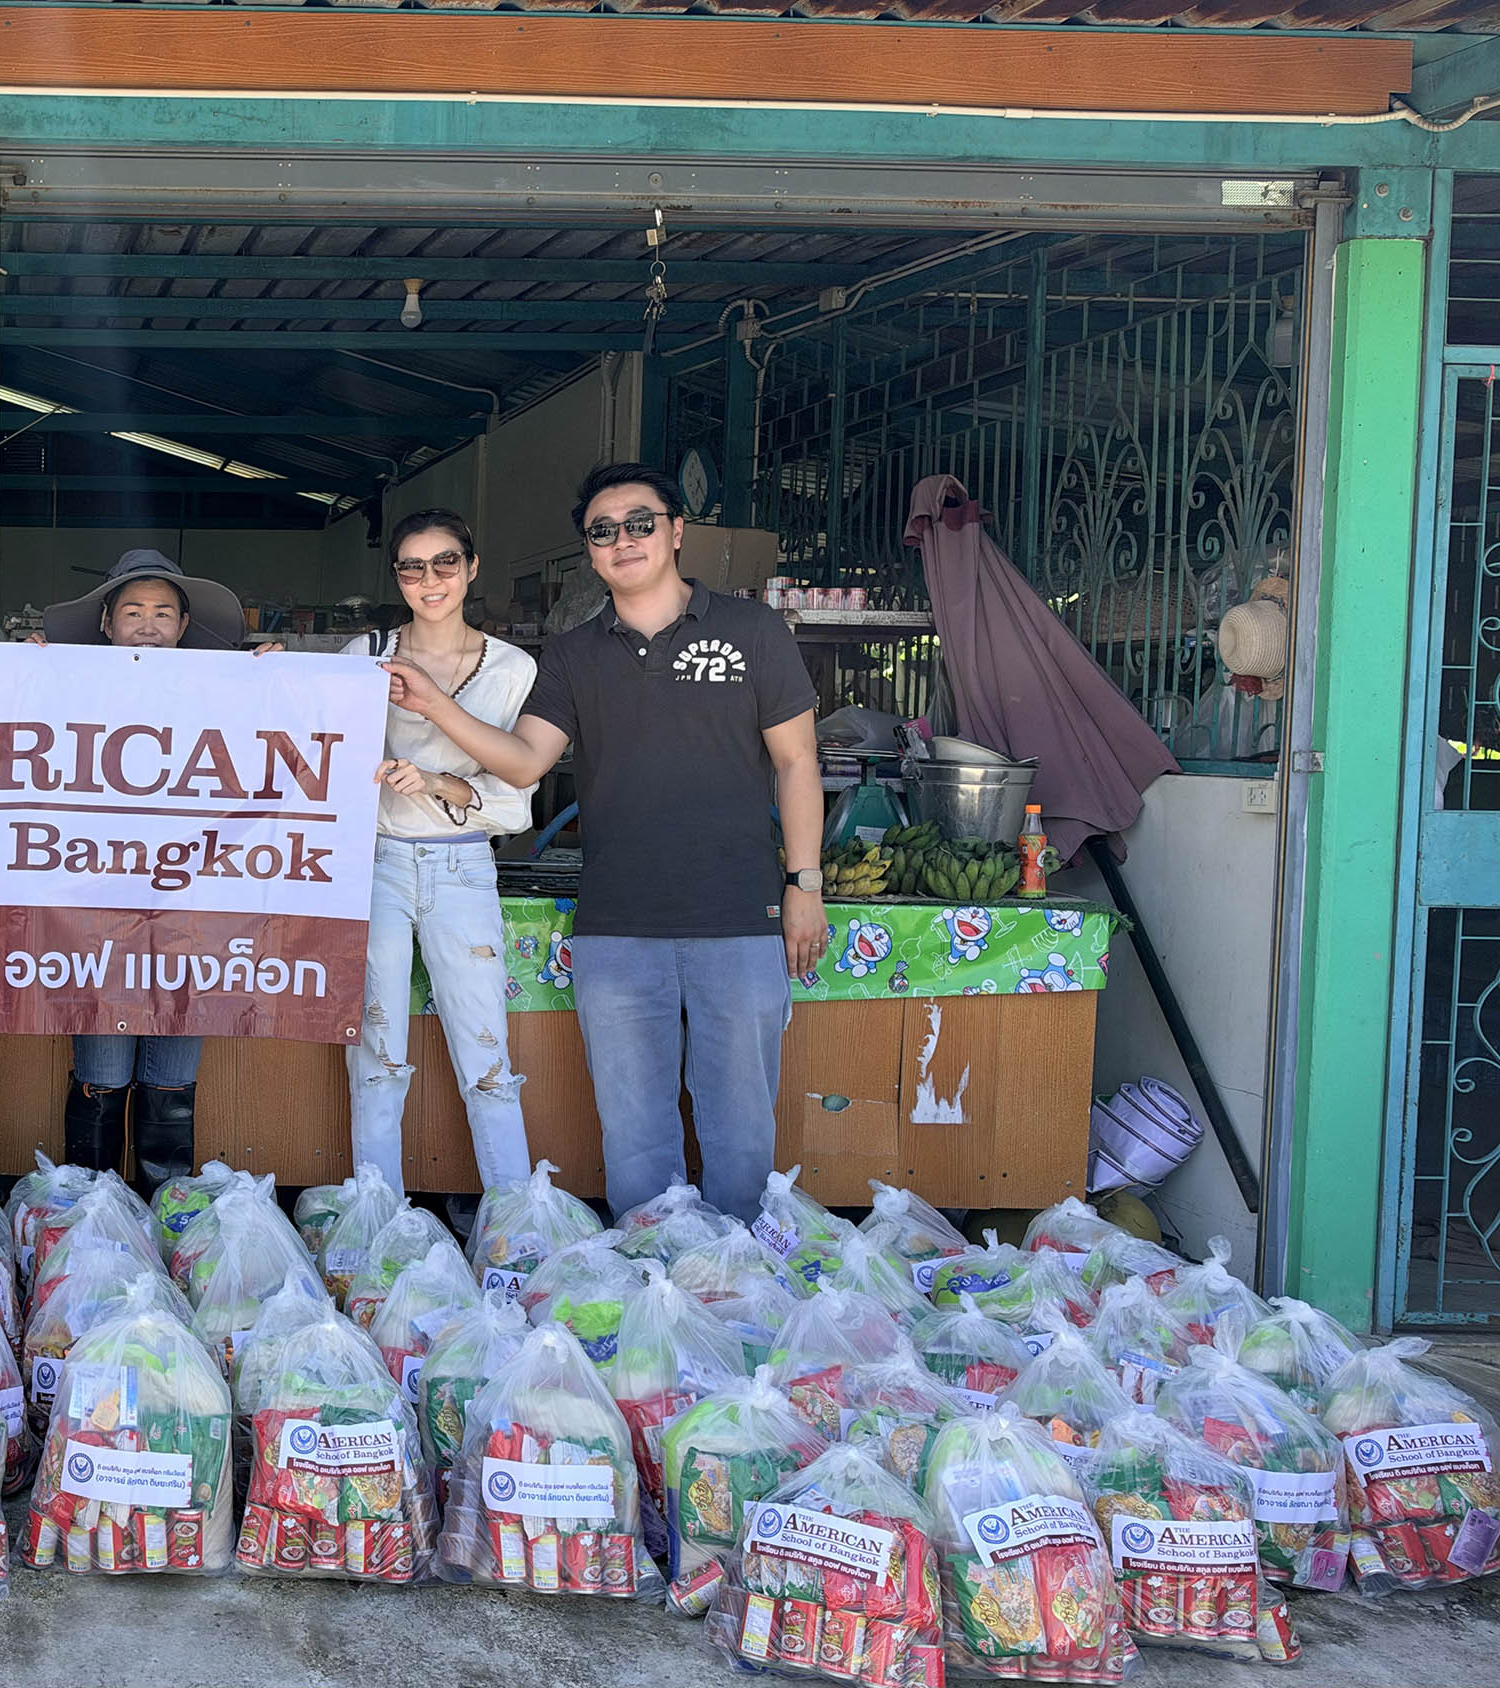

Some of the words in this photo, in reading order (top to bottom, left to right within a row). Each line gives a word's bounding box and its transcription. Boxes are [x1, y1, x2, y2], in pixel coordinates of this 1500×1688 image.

[673, 640, 746, 671] SUPERDRY
[692, 657, 726, 681] 72
[5, 825, 332, 892] Bangkok
[4, 938, 106, 990] ออฟ
[123, 938, 327, 998] แบงค็อก
[341, 1451, 350, 1459] of
[353, 1448, 394, 1459] Bangkok
[1387, 1435, 1475, 1451] AMERICAN
[1388, 1453, 1422, 1463] School
[1426, 1451, 1436, 1459] of
[1437, 1447, 1480, 1460] Bangkok
[1011, 1505, 1086, 1526] AMERICAN
[783, 1513, 883, 1554] AMERICAN
[1014, 1521, 1049, 1538] School
[1050, 1521, 1058, 1529] of
[1059, 1522, 1092, 1532] Bangkok
[781, 1533, 812, 1547] School
[815, 1540, 828, 1550] of
[830, 1544, 880, 1566] Bangkok
[1157, 1547, 1196, 1558] School
[1199, 1549, 1211, 1558] of
[1213, 1551, 1256, 1560] Bangkok
